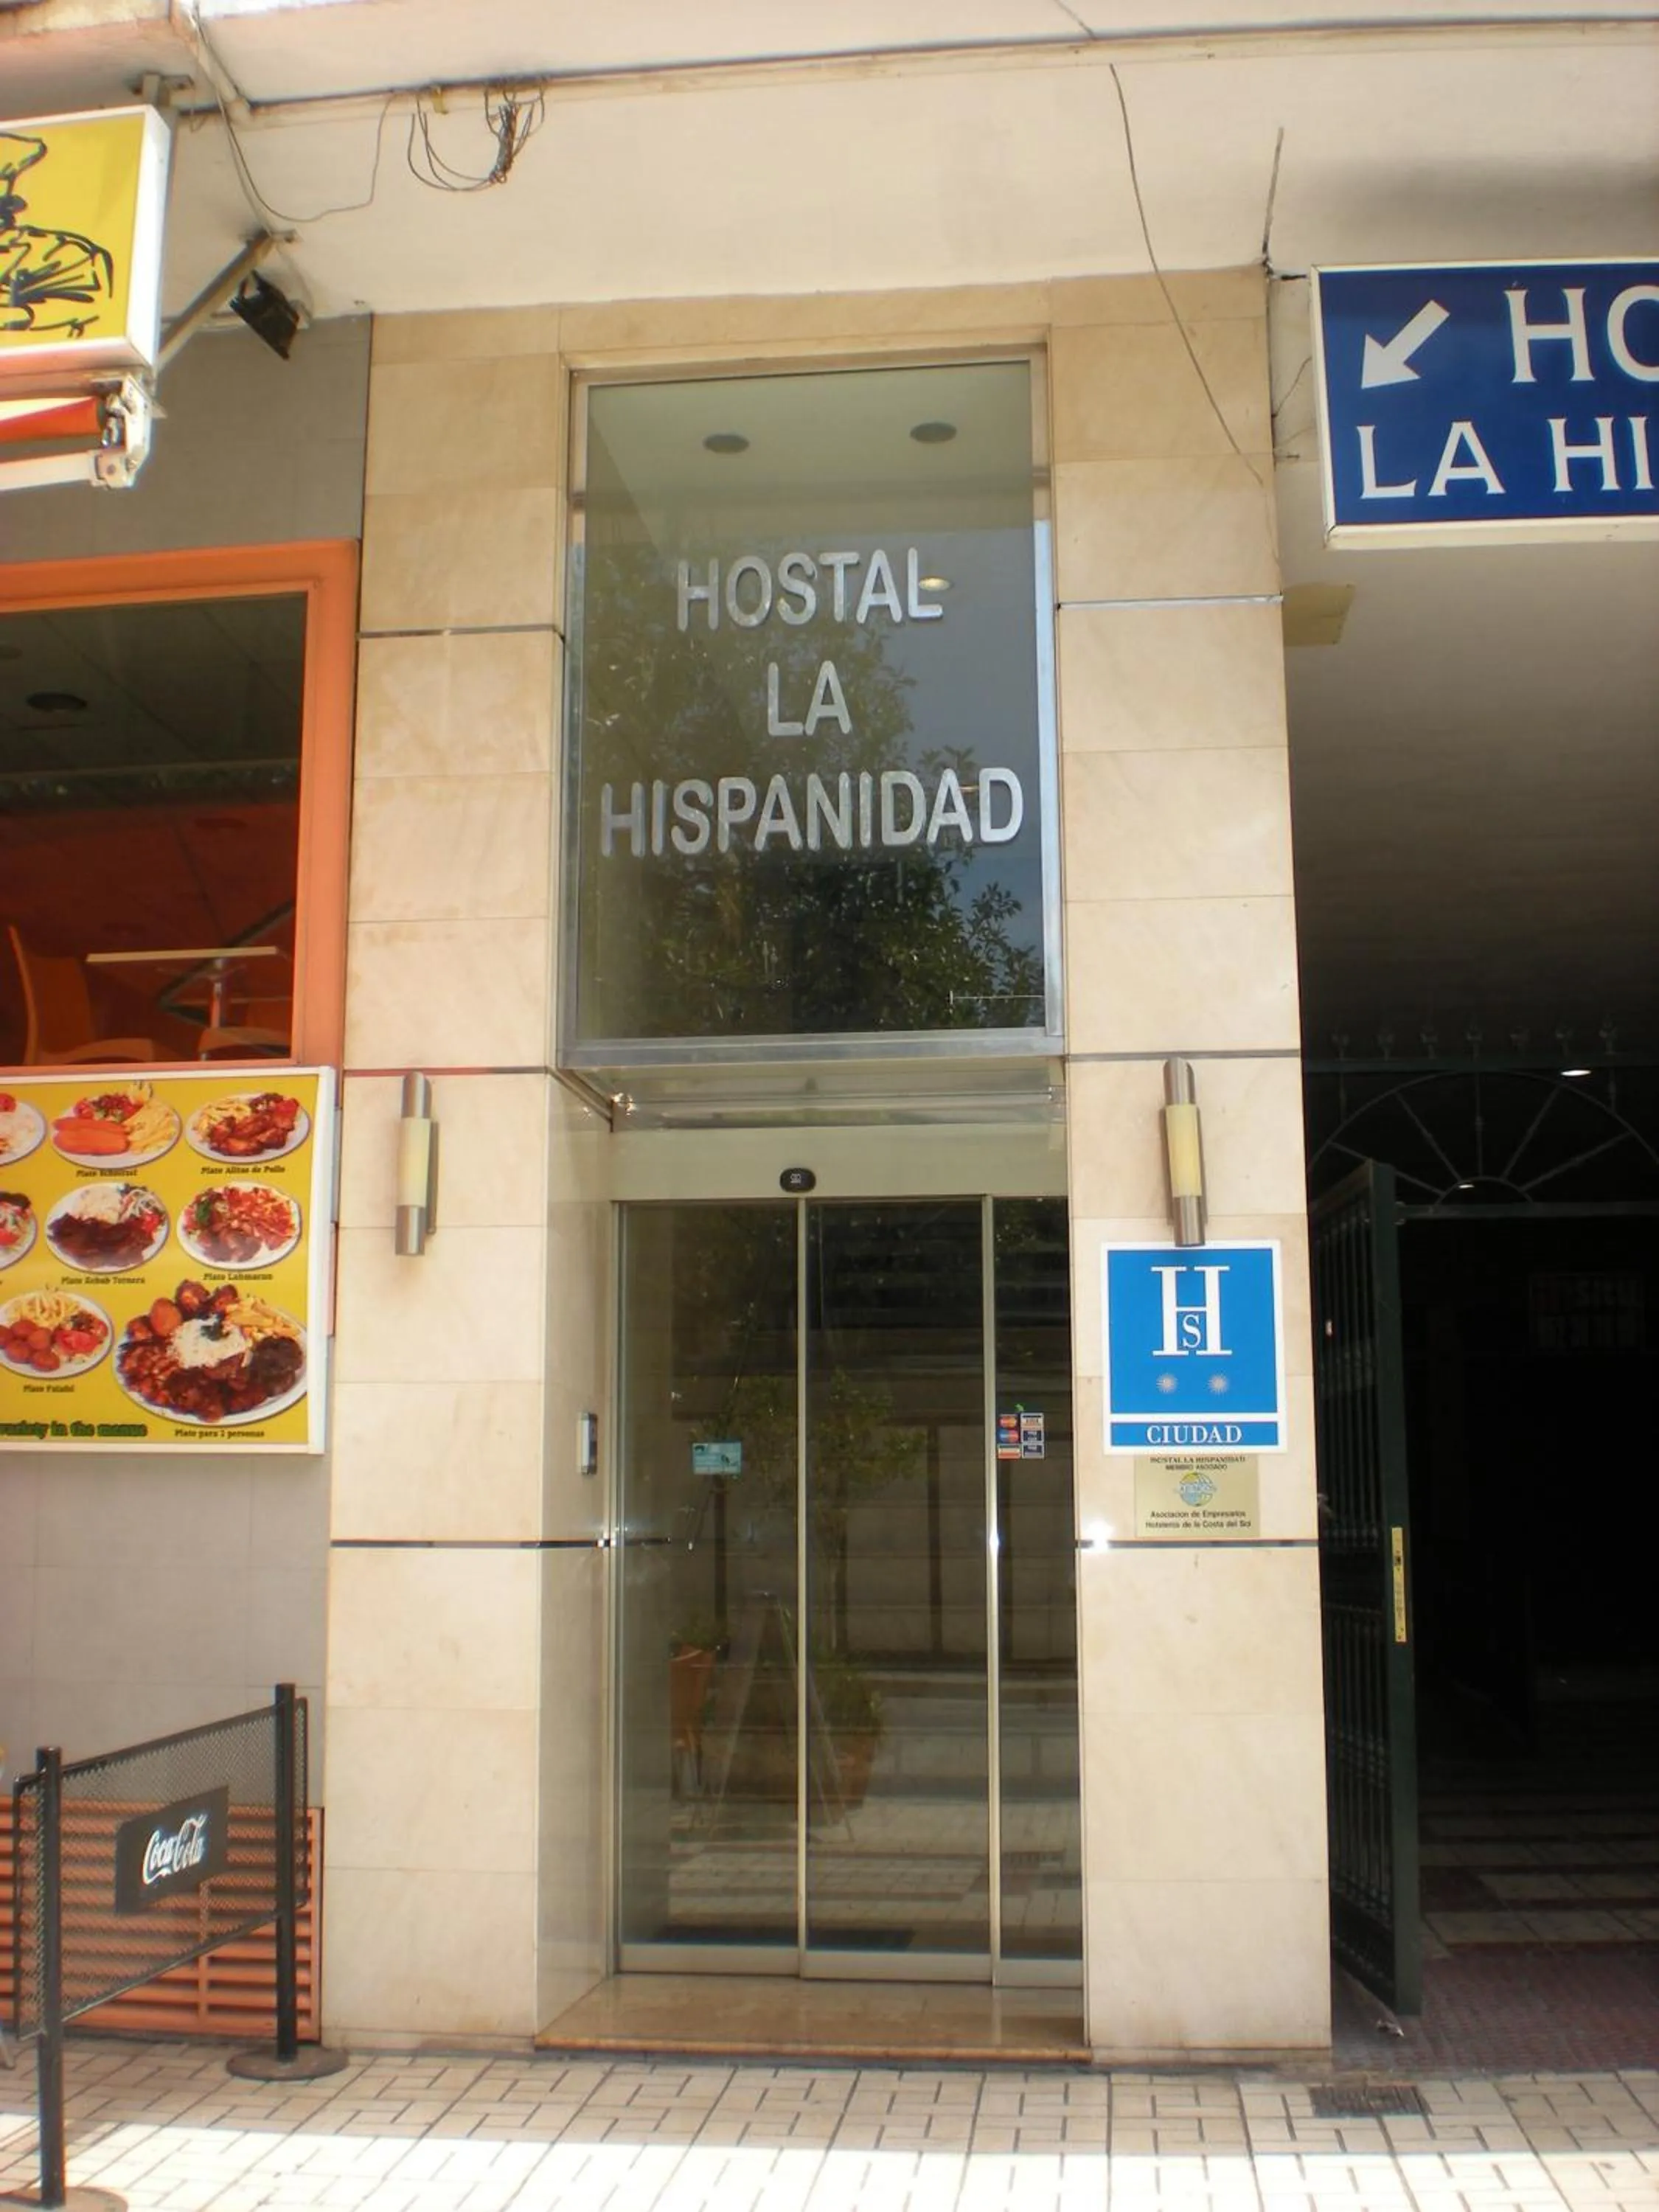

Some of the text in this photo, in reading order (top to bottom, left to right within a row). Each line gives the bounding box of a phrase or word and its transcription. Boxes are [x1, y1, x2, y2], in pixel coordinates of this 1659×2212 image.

[1357, 416, 1656, 499] LA HI
[677, 547, 944, 632] HOSTAL
[767, 660, 852, 737] LA
[600, 767, 1024, 858] HISPANIDAD
[1146, 1425, 1242, 1445] CIUDAD
